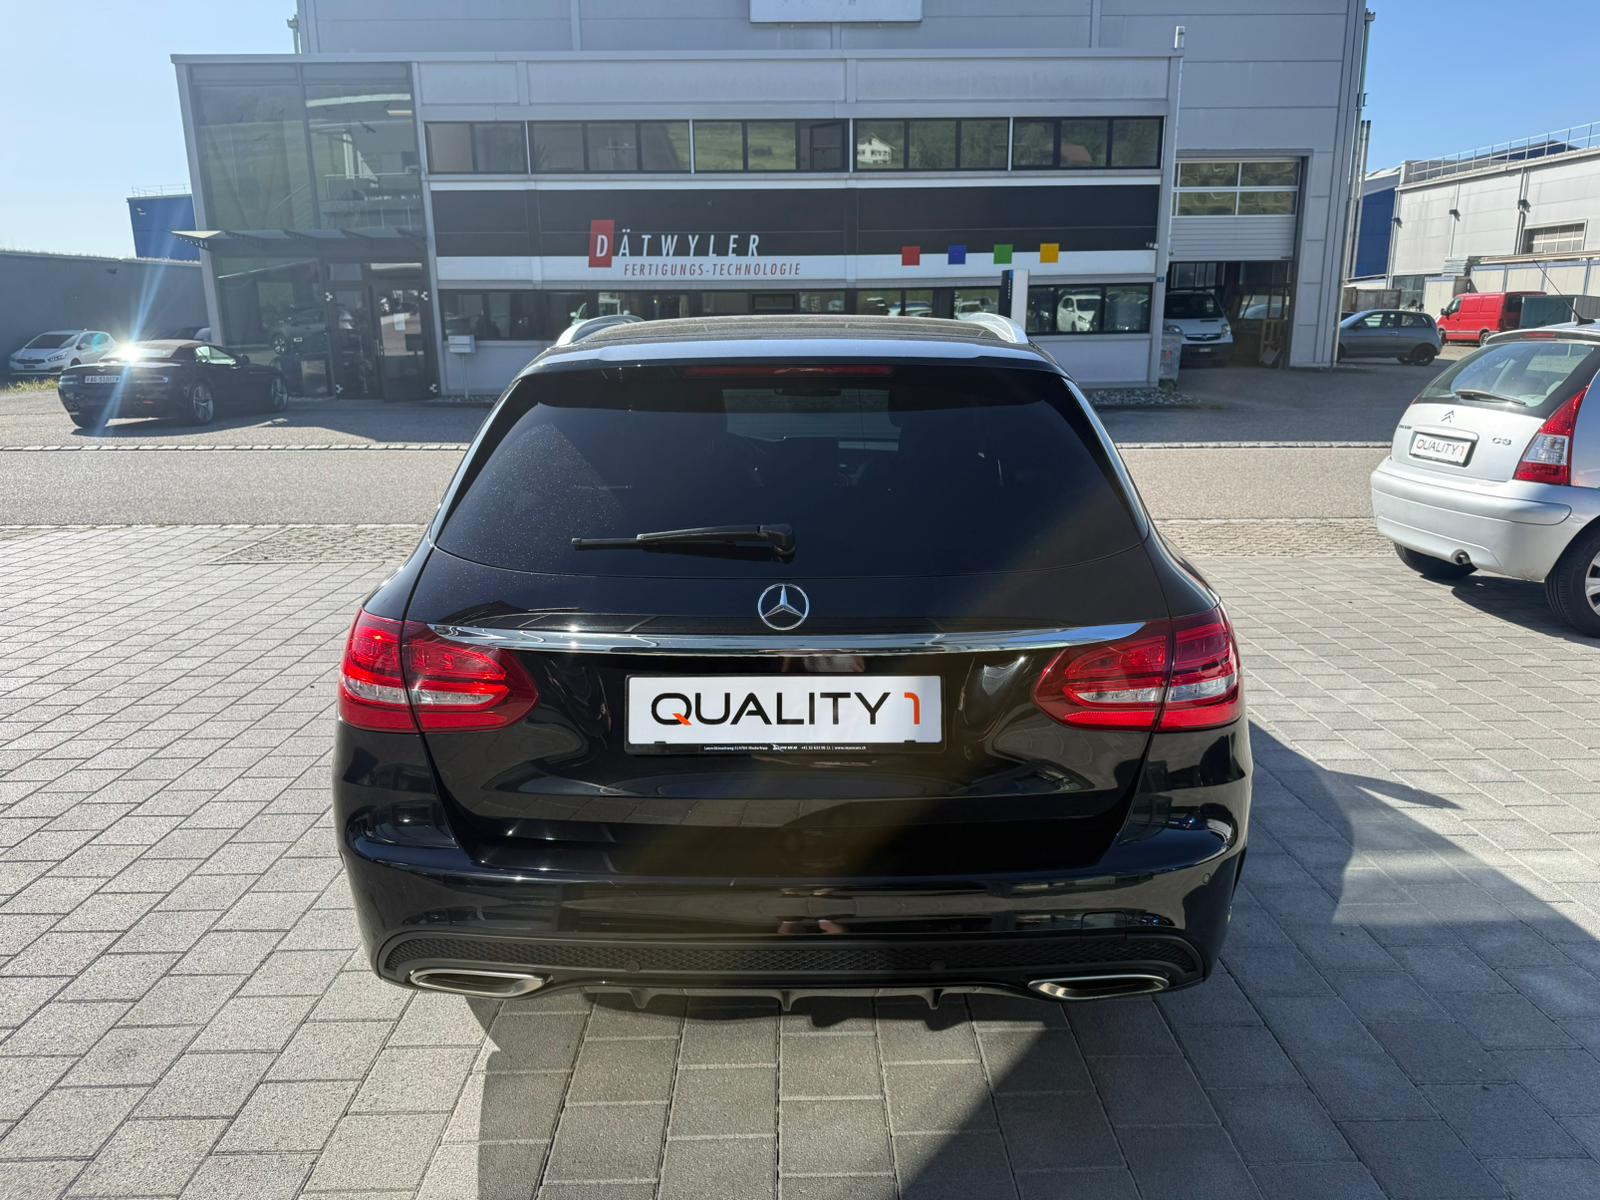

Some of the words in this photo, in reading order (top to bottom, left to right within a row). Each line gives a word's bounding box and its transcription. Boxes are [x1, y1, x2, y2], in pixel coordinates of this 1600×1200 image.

[596, 229, 760, 257] DÄTWYLER
[624, 263, 800, 276] FERTIGUNGS-TECHNOLOGIE
[1416, 439, 1460, 455] QUALITY
[1492, 437, 1512, 446] C3
[651, 692, 891, 725] QUALITY
[904, 692, 920, 725] 1
